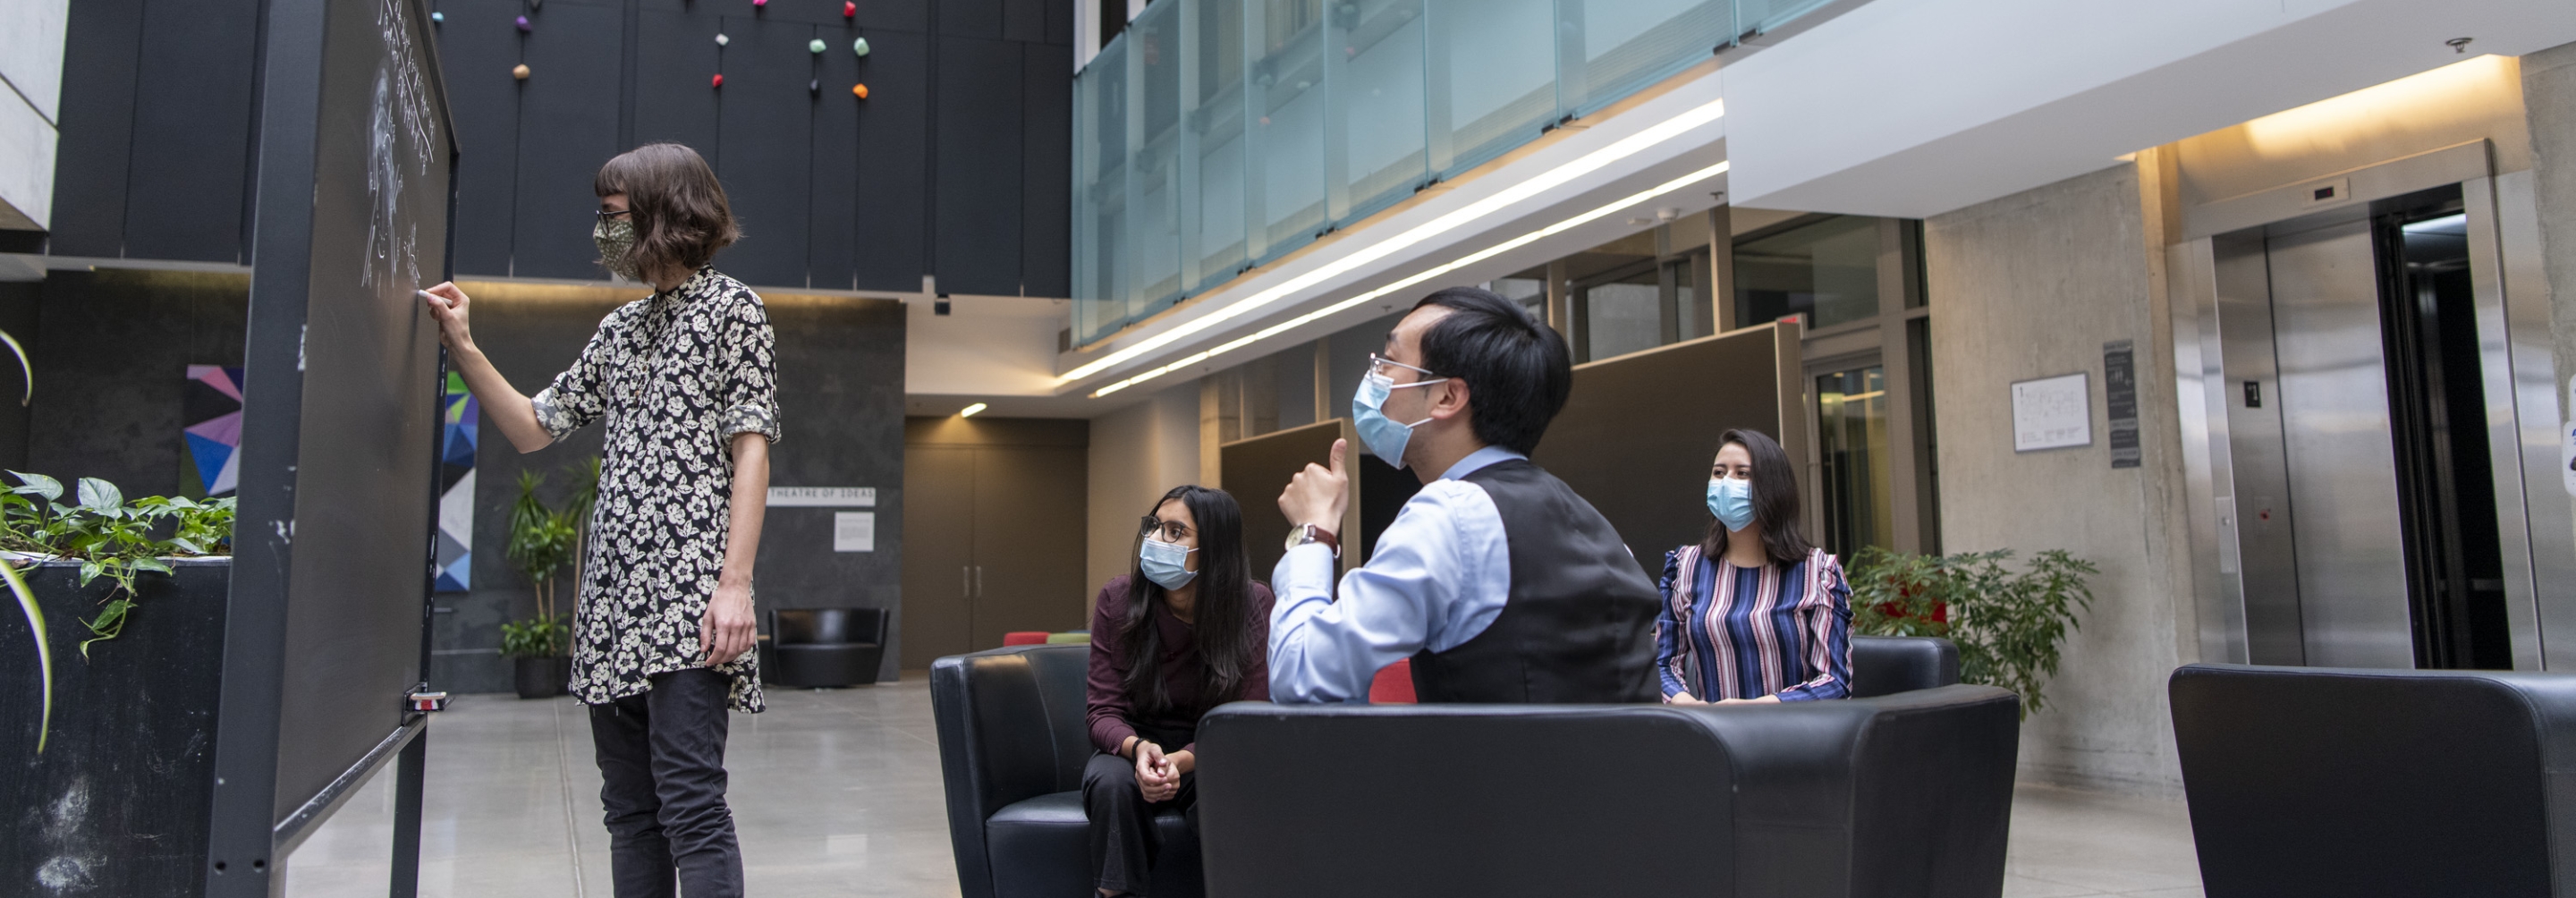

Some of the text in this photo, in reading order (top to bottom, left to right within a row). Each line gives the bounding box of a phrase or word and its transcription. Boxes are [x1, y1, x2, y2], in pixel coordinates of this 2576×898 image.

[771, 489, 874, 498] THEATRE OF IDEAS
